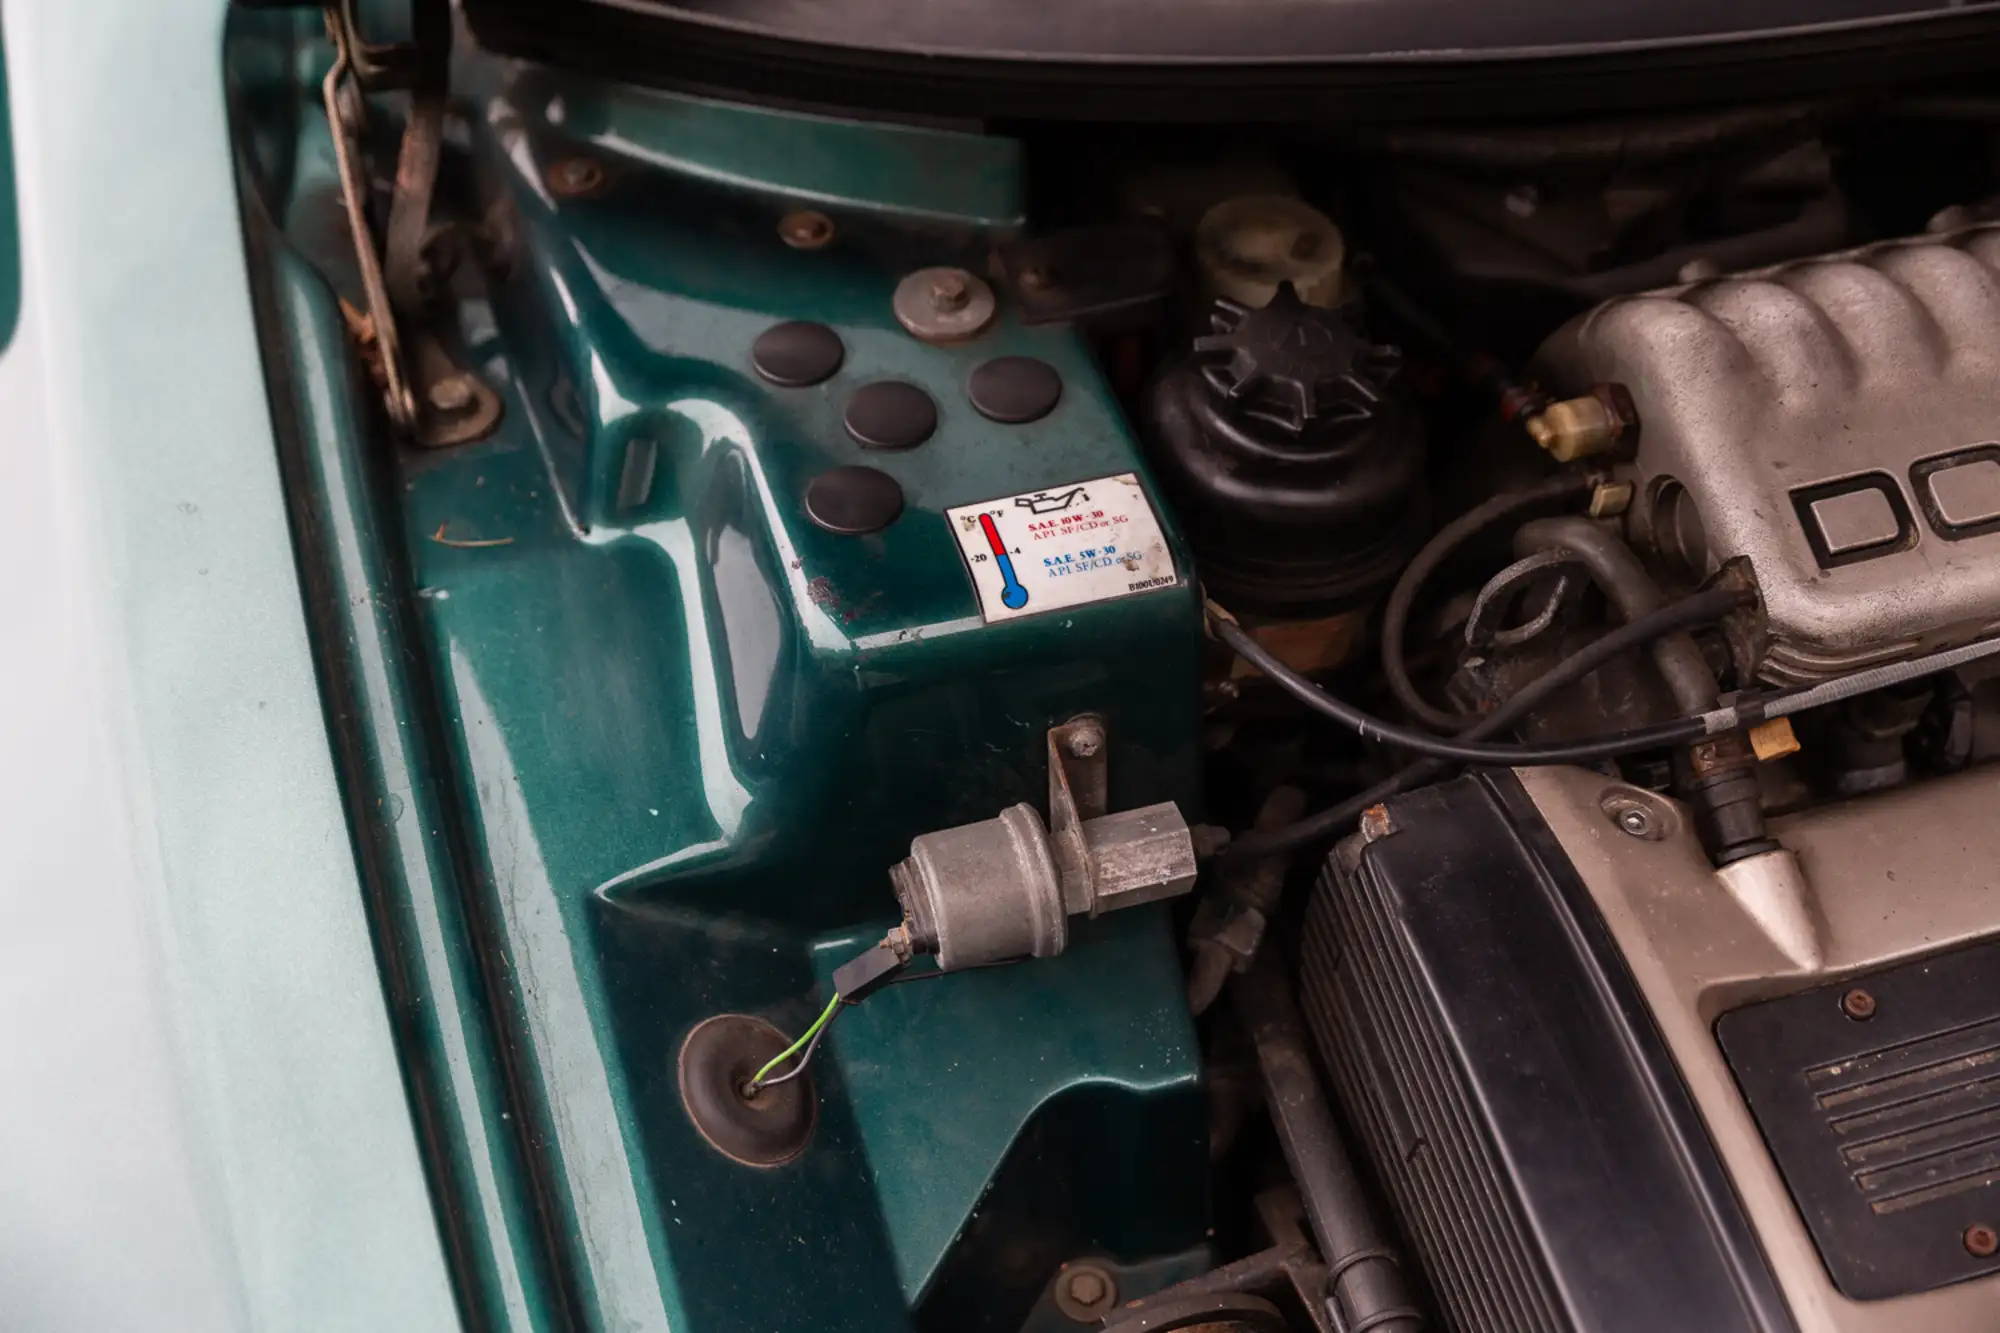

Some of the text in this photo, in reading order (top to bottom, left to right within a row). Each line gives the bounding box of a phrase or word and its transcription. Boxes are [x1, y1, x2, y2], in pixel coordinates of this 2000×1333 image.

[1091, 510, 1104, 519] 30
[1034, 530, 1056, 541] API
[1060, 520, 1098, 535] SF/CD
[1112, 514, 1129, 524] SG
[971, 553, 988, 563] -20
[1079, 548, 1097, 560] 5W
[1103, 545, 1116, 554] 30
[1049, 565, 1072, 578] API
[1075, 556, 1113, 572] SF/CD
[1126, 551, 1142, 561] SG
